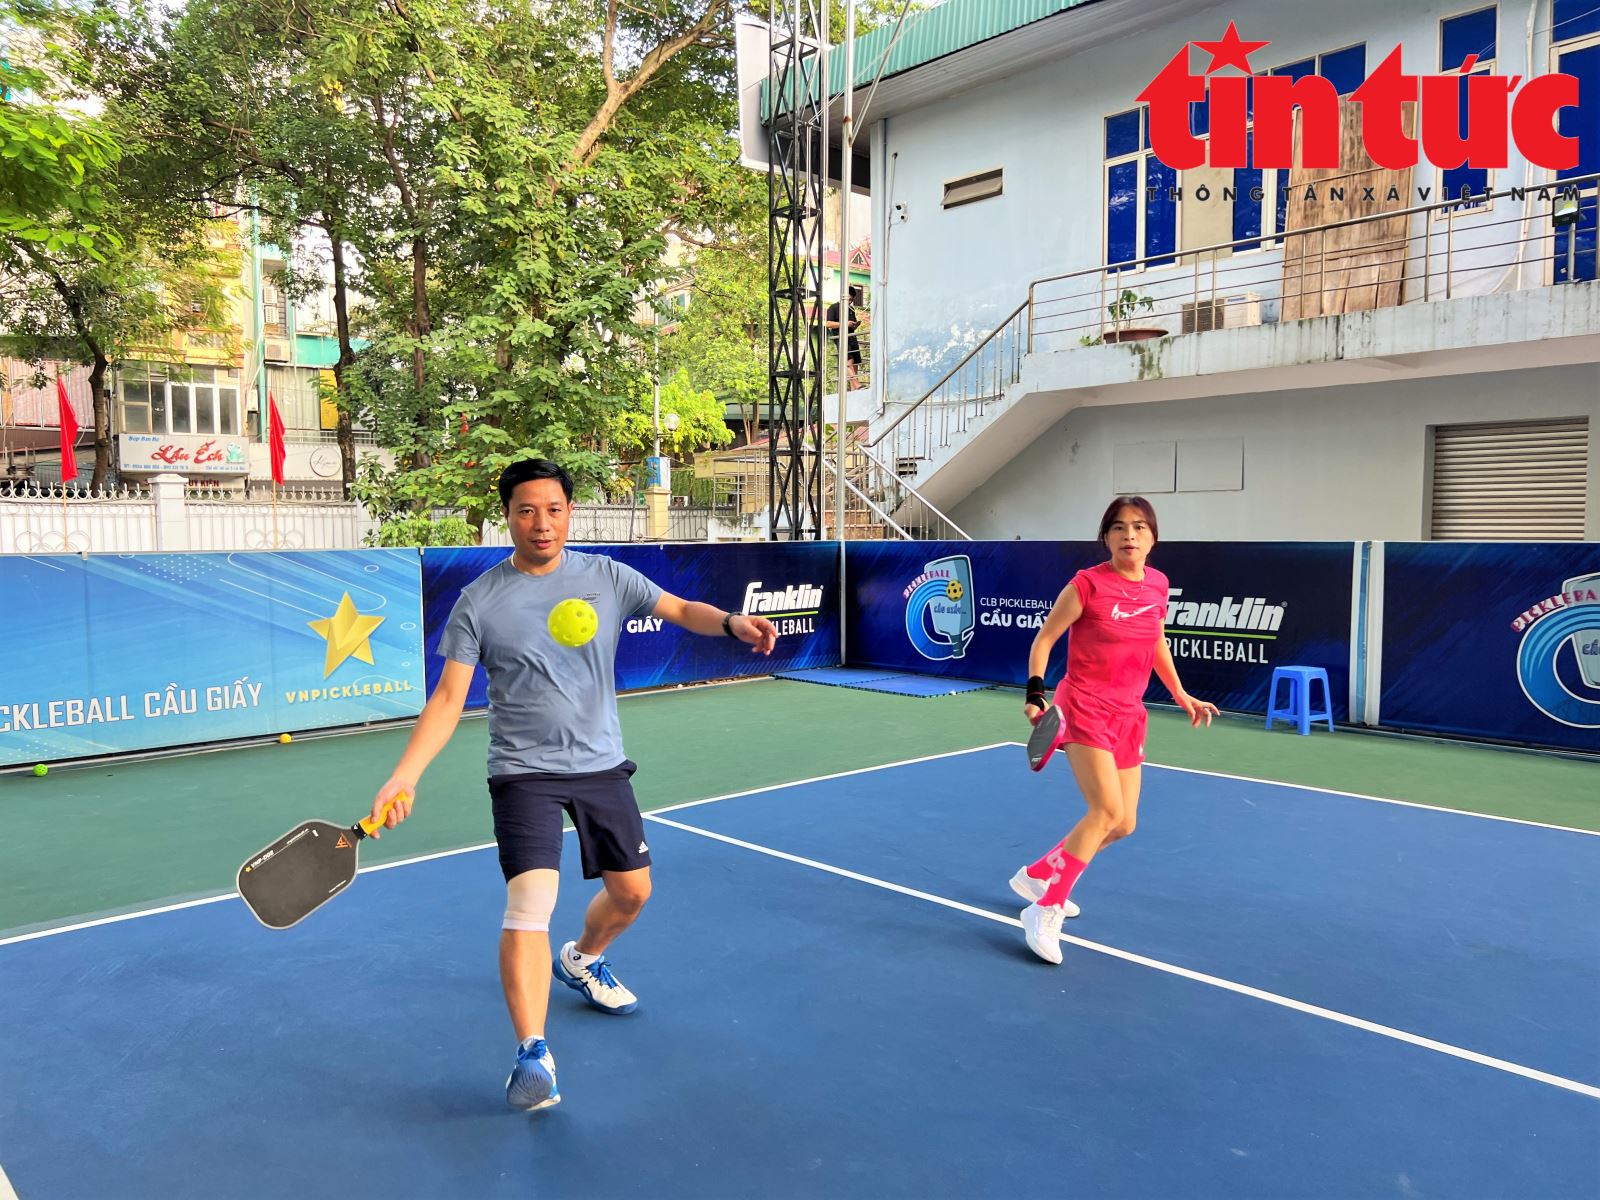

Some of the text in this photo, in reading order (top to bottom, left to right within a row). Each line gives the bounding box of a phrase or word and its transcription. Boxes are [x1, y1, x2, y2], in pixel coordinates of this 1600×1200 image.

[980, 597, 1054, 609] CLB PICKLEBALL
[771, 617, 815, 636] LEBALL
[980, 608, 1012, 627] CẦU
[1016, 610, 1048, 629] GIẤ
[144, 682, 197, 718] CẦU
[206, 676, 262, 711] GIẤY
[285, 679, 412, 704] VNPICKLEBALL
